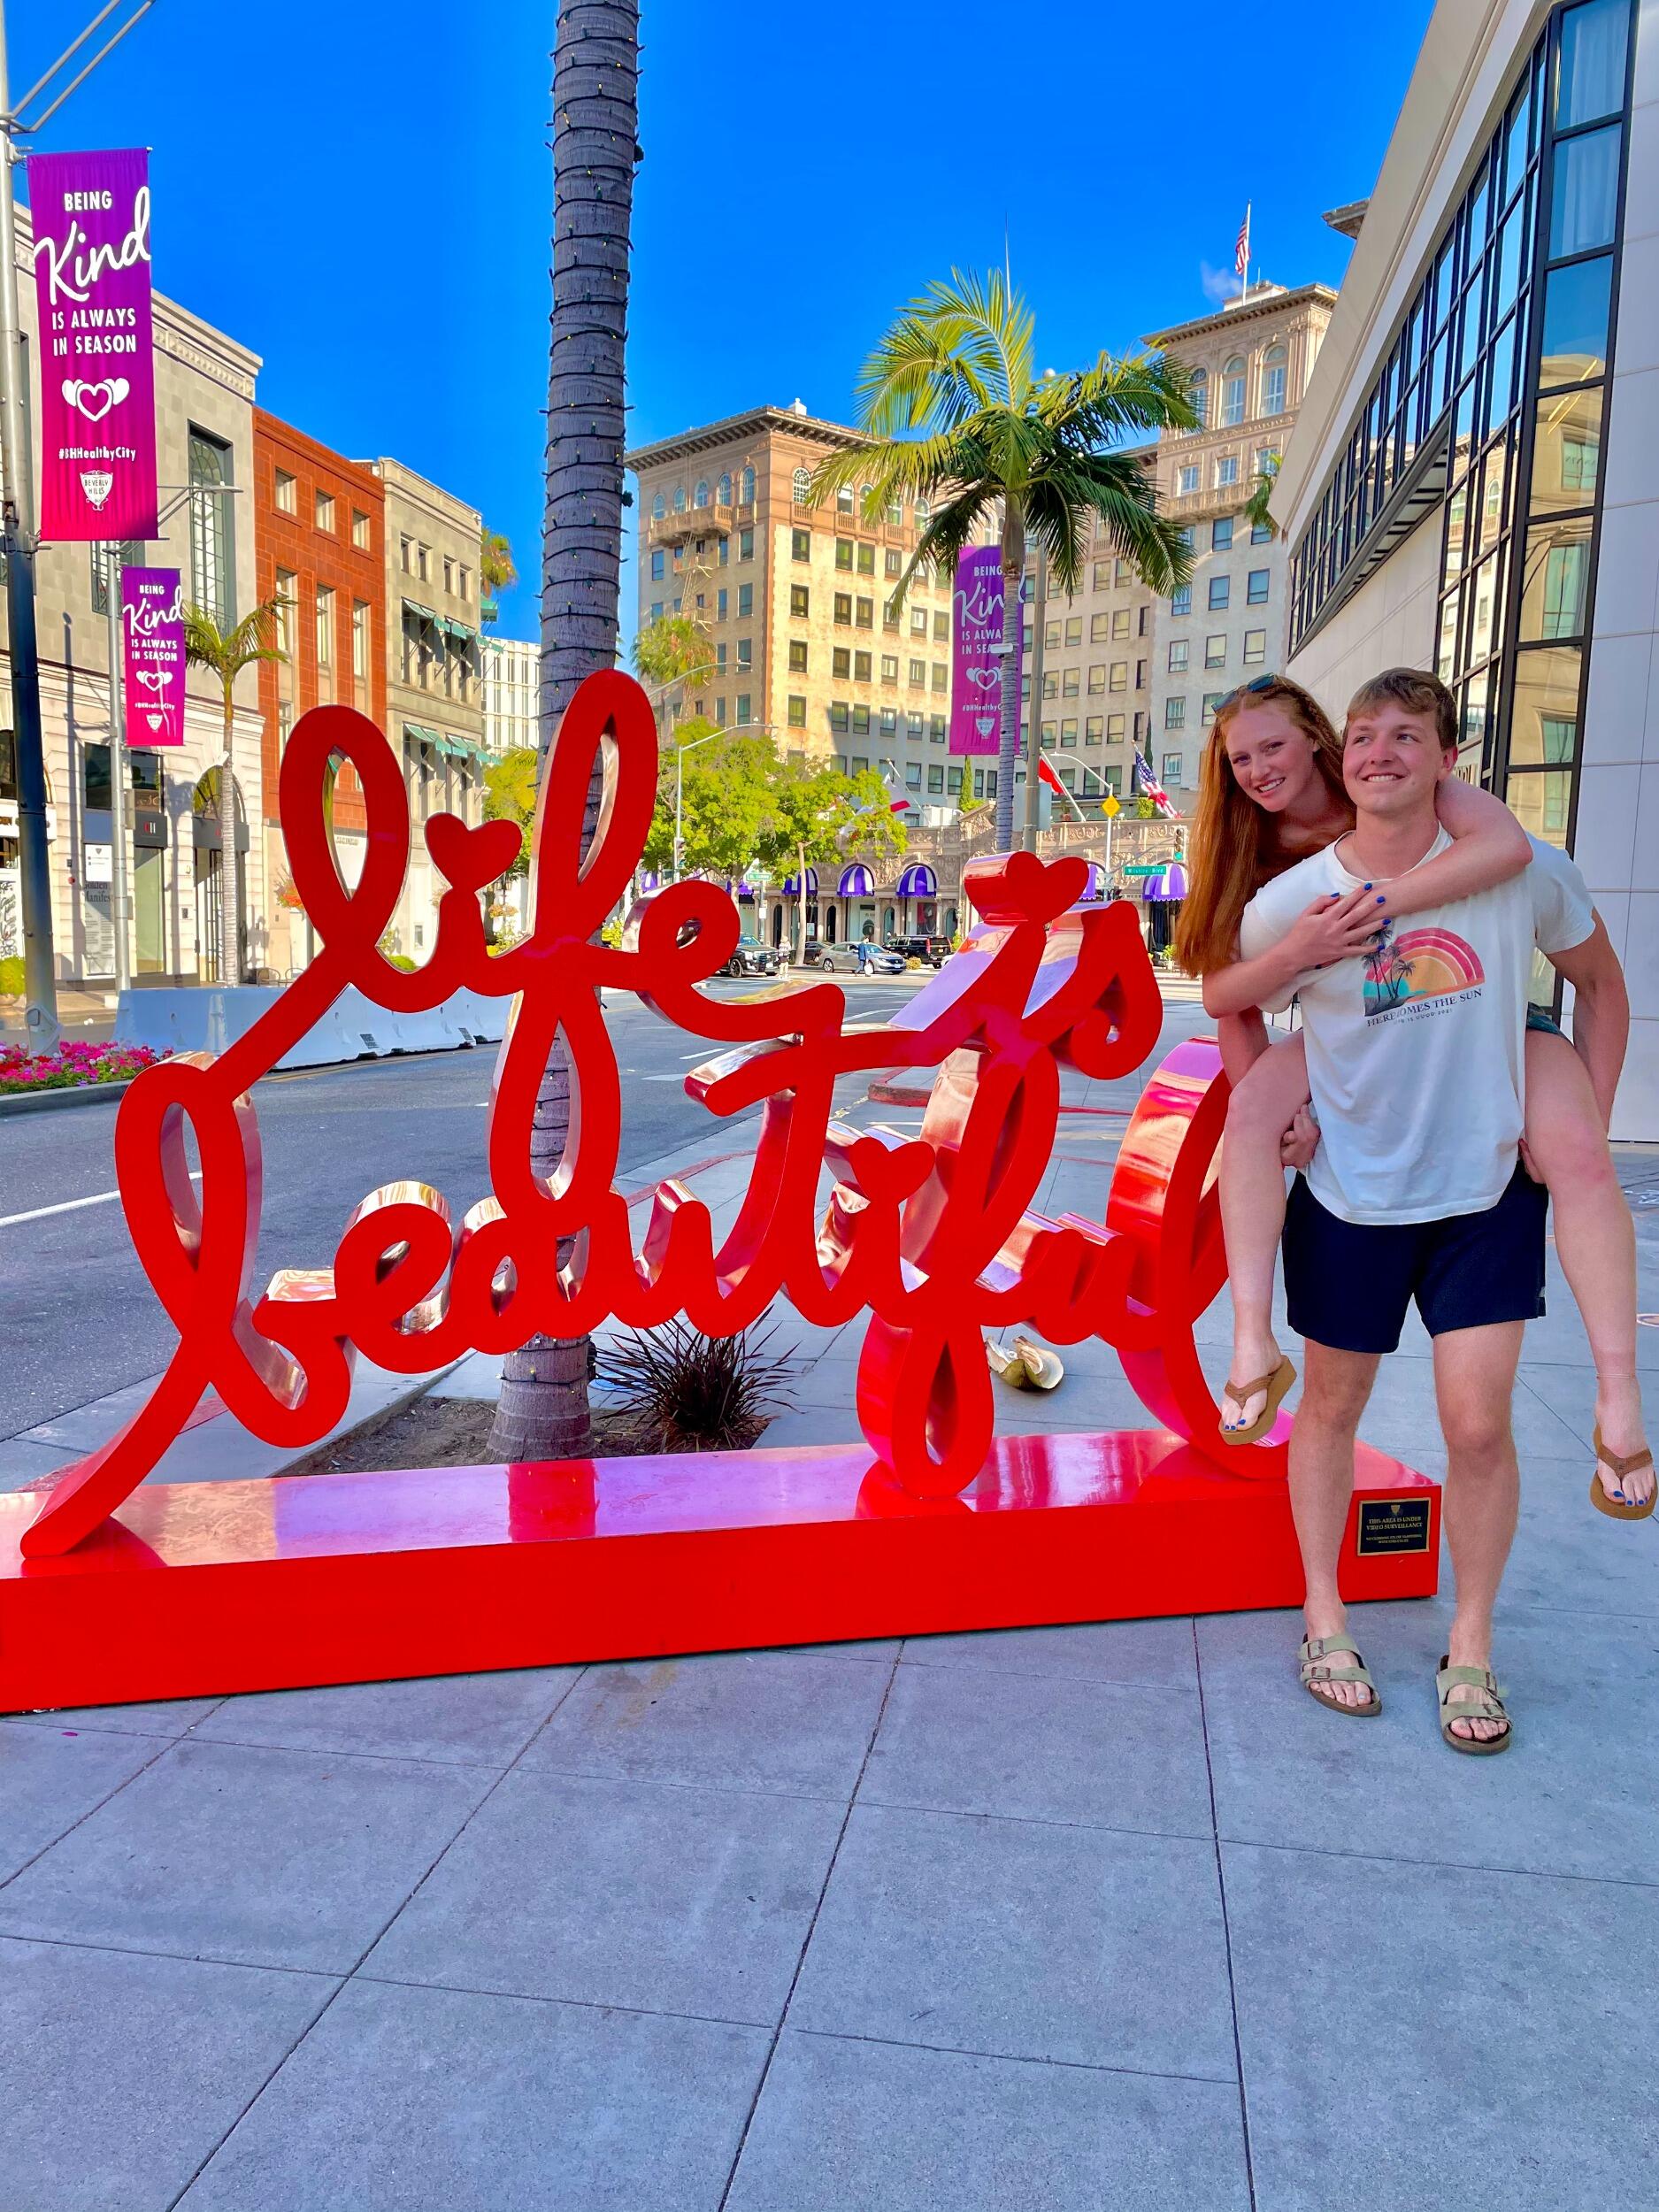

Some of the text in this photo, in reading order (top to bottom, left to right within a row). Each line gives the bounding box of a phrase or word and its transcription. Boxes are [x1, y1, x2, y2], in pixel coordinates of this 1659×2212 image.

[64, 189, 112, 211] BEING
[34, 185, 151, 305] Kind
[51, 307, 136, 330] IS ALWAYS
[53, 334, 136, 357] IN SEASON
[58, 446, 136, 462] #BHHealthyCity
[973, 565, 1003, 576] BEING
[139, 585, 165, 594] BEING
[122, 585, 183, 636] Kind
[131, 638, 178, 649] IS ALWAYS
[962, 628, 1003, 641] IS ALWA
[132, 650, 178, 662] IN SEASON
[962, 643, 992, 655] IN SEA
[280, 670, 841, 1232] life
[938, 851, 1164, 1081] is
[1367, 988, 1482, 1027] HERE OMES THE SUN
[22, 1037, 1294, 1557] beautiful
